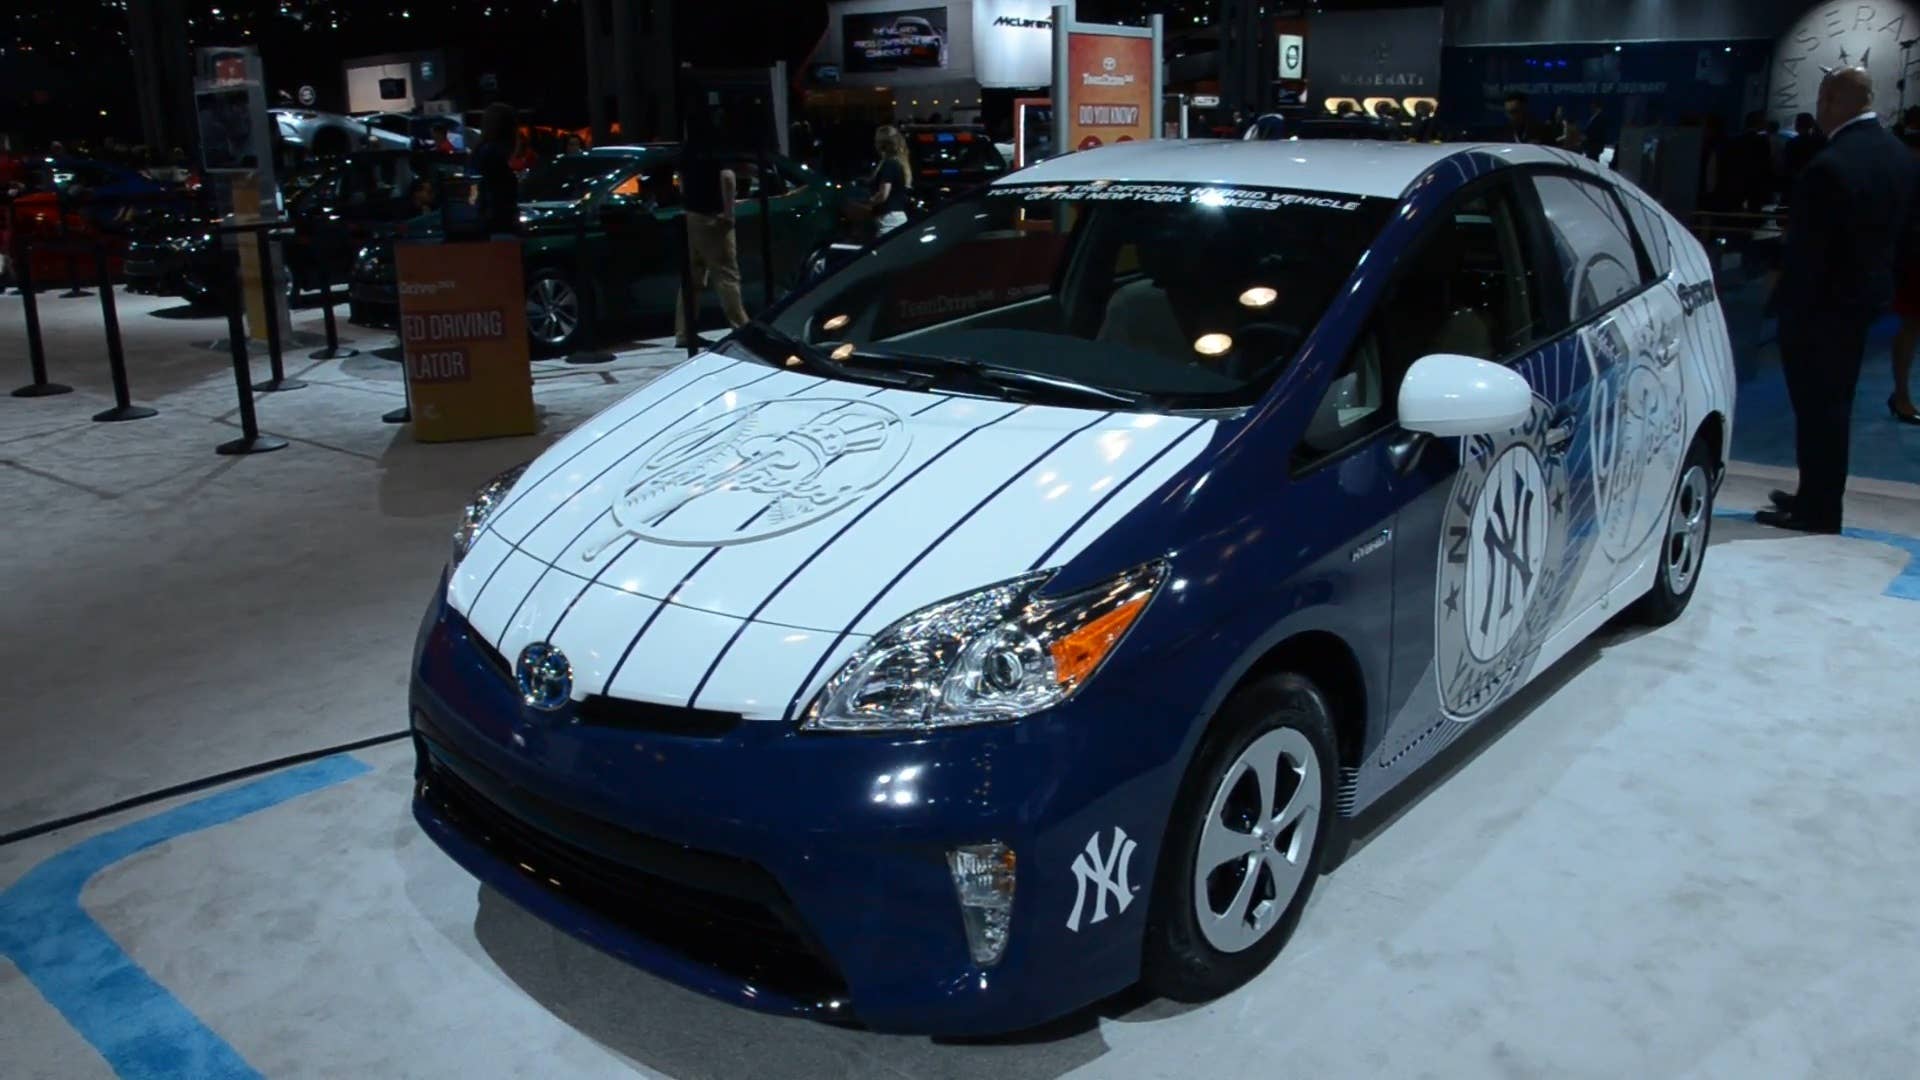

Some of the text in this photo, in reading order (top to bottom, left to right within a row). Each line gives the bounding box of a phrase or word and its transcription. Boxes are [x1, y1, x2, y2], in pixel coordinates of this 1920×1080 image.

[993, 15, 1052, 29] McLaren
[1079, 105, 1138, 124] DID YOU KNOW?
[1051, 192, 1087, 200] THE
[1086, 192, 1133, 200] NEW
[1133, 193, 1183, 202] YORK
[1107, 185, 1186, 194] OFFICIAL
[1271, 193, 1360, 211] VEHICLE
[430, 311, 503, 340] DRIVING
[1066, 826, 1137, 932] NY
